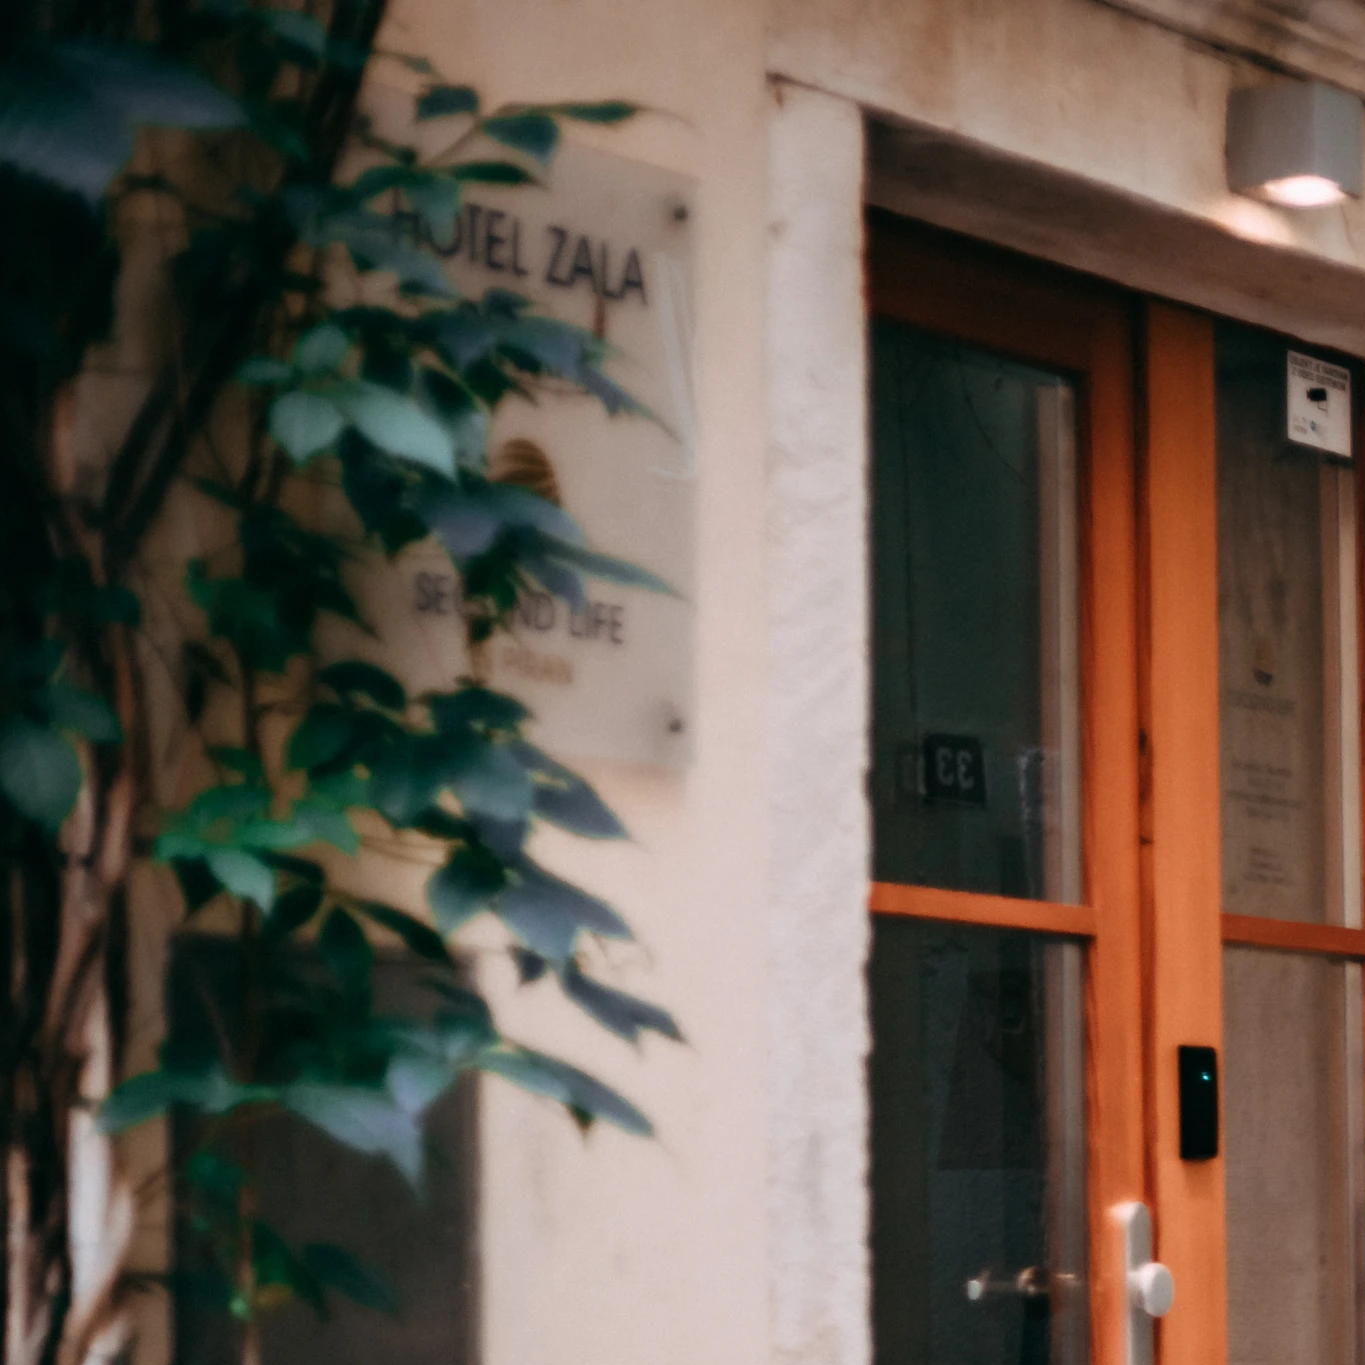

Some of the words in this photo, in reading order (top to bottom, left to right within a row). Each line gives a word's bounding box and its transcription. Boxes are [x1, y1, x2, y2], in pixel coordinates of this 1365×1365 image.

[546, 224, 649, 307] ZALA
[414, 570, 557, 633] SEND
[569, 602, 624, 646] LIFE
